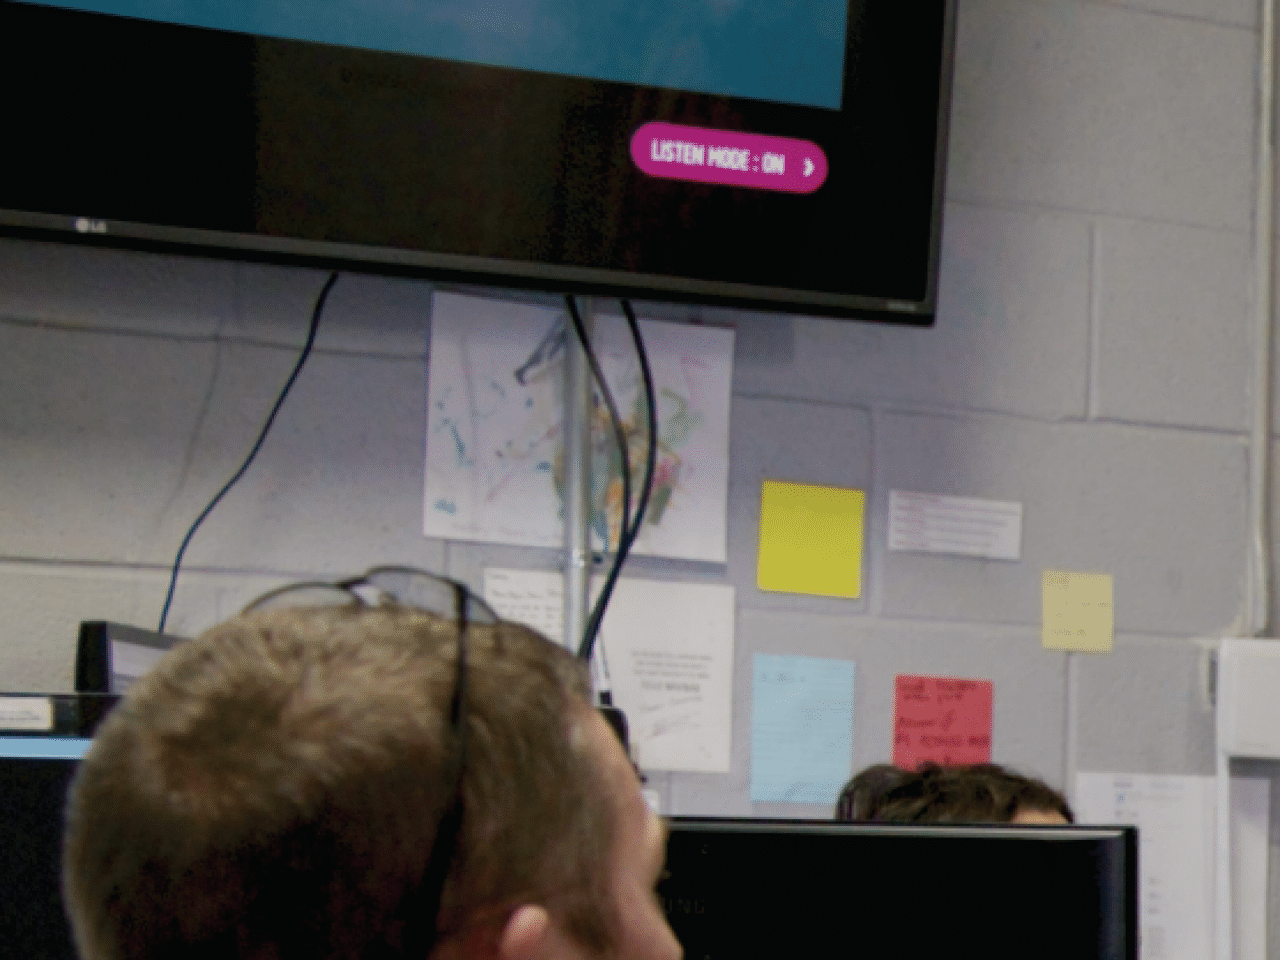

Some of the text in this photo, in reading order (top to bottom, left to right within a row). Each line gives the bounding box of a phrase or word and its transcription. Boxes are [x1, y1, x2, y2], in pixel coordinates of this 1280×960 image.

[651, 138, 705, 166] LISTEN
[707, 145, 750, 171] MODE
[761, 151, 786, 175] ON
